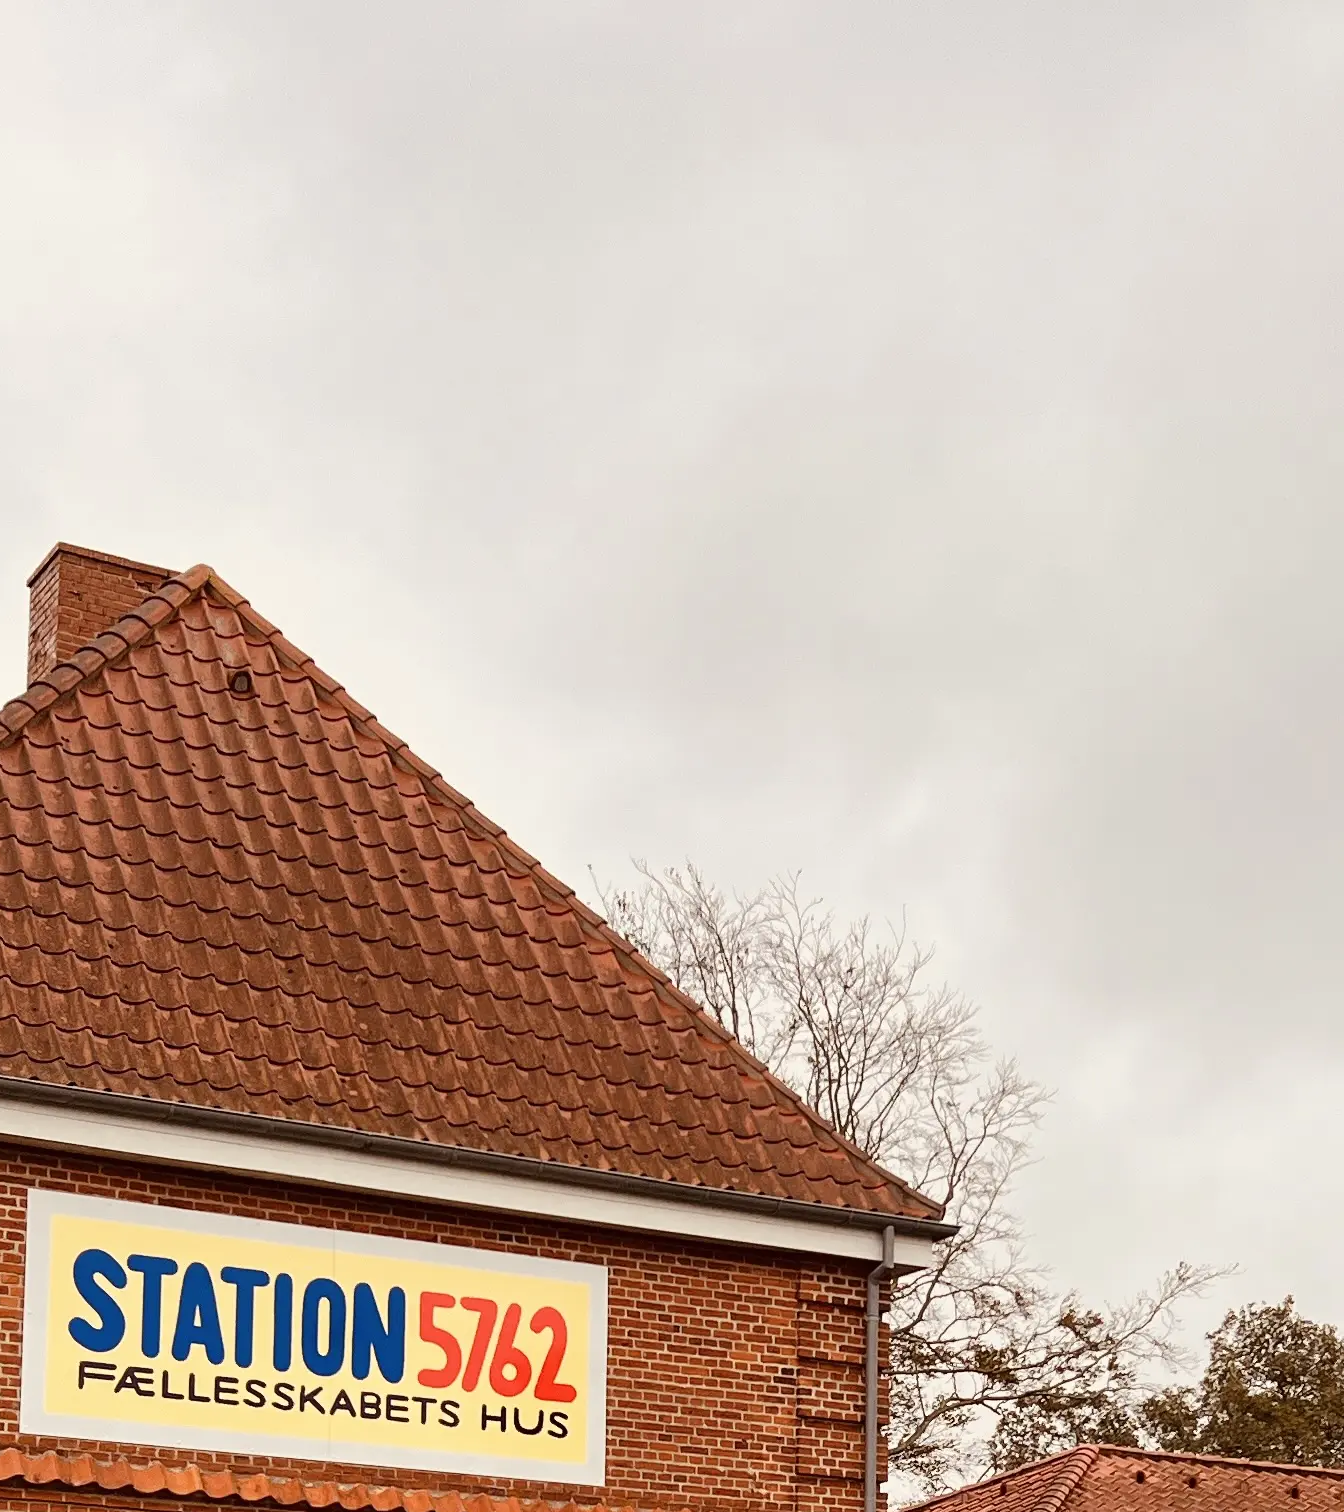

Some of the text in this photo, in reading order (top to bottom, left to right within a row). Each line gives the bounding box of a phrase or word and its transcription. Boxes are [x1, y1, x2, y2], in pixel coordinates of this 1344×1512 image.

[69, 1249, 578, 1403] STATION 5762
[78, 1360, 569, 1439] FÆLLESSKABETS HUS
